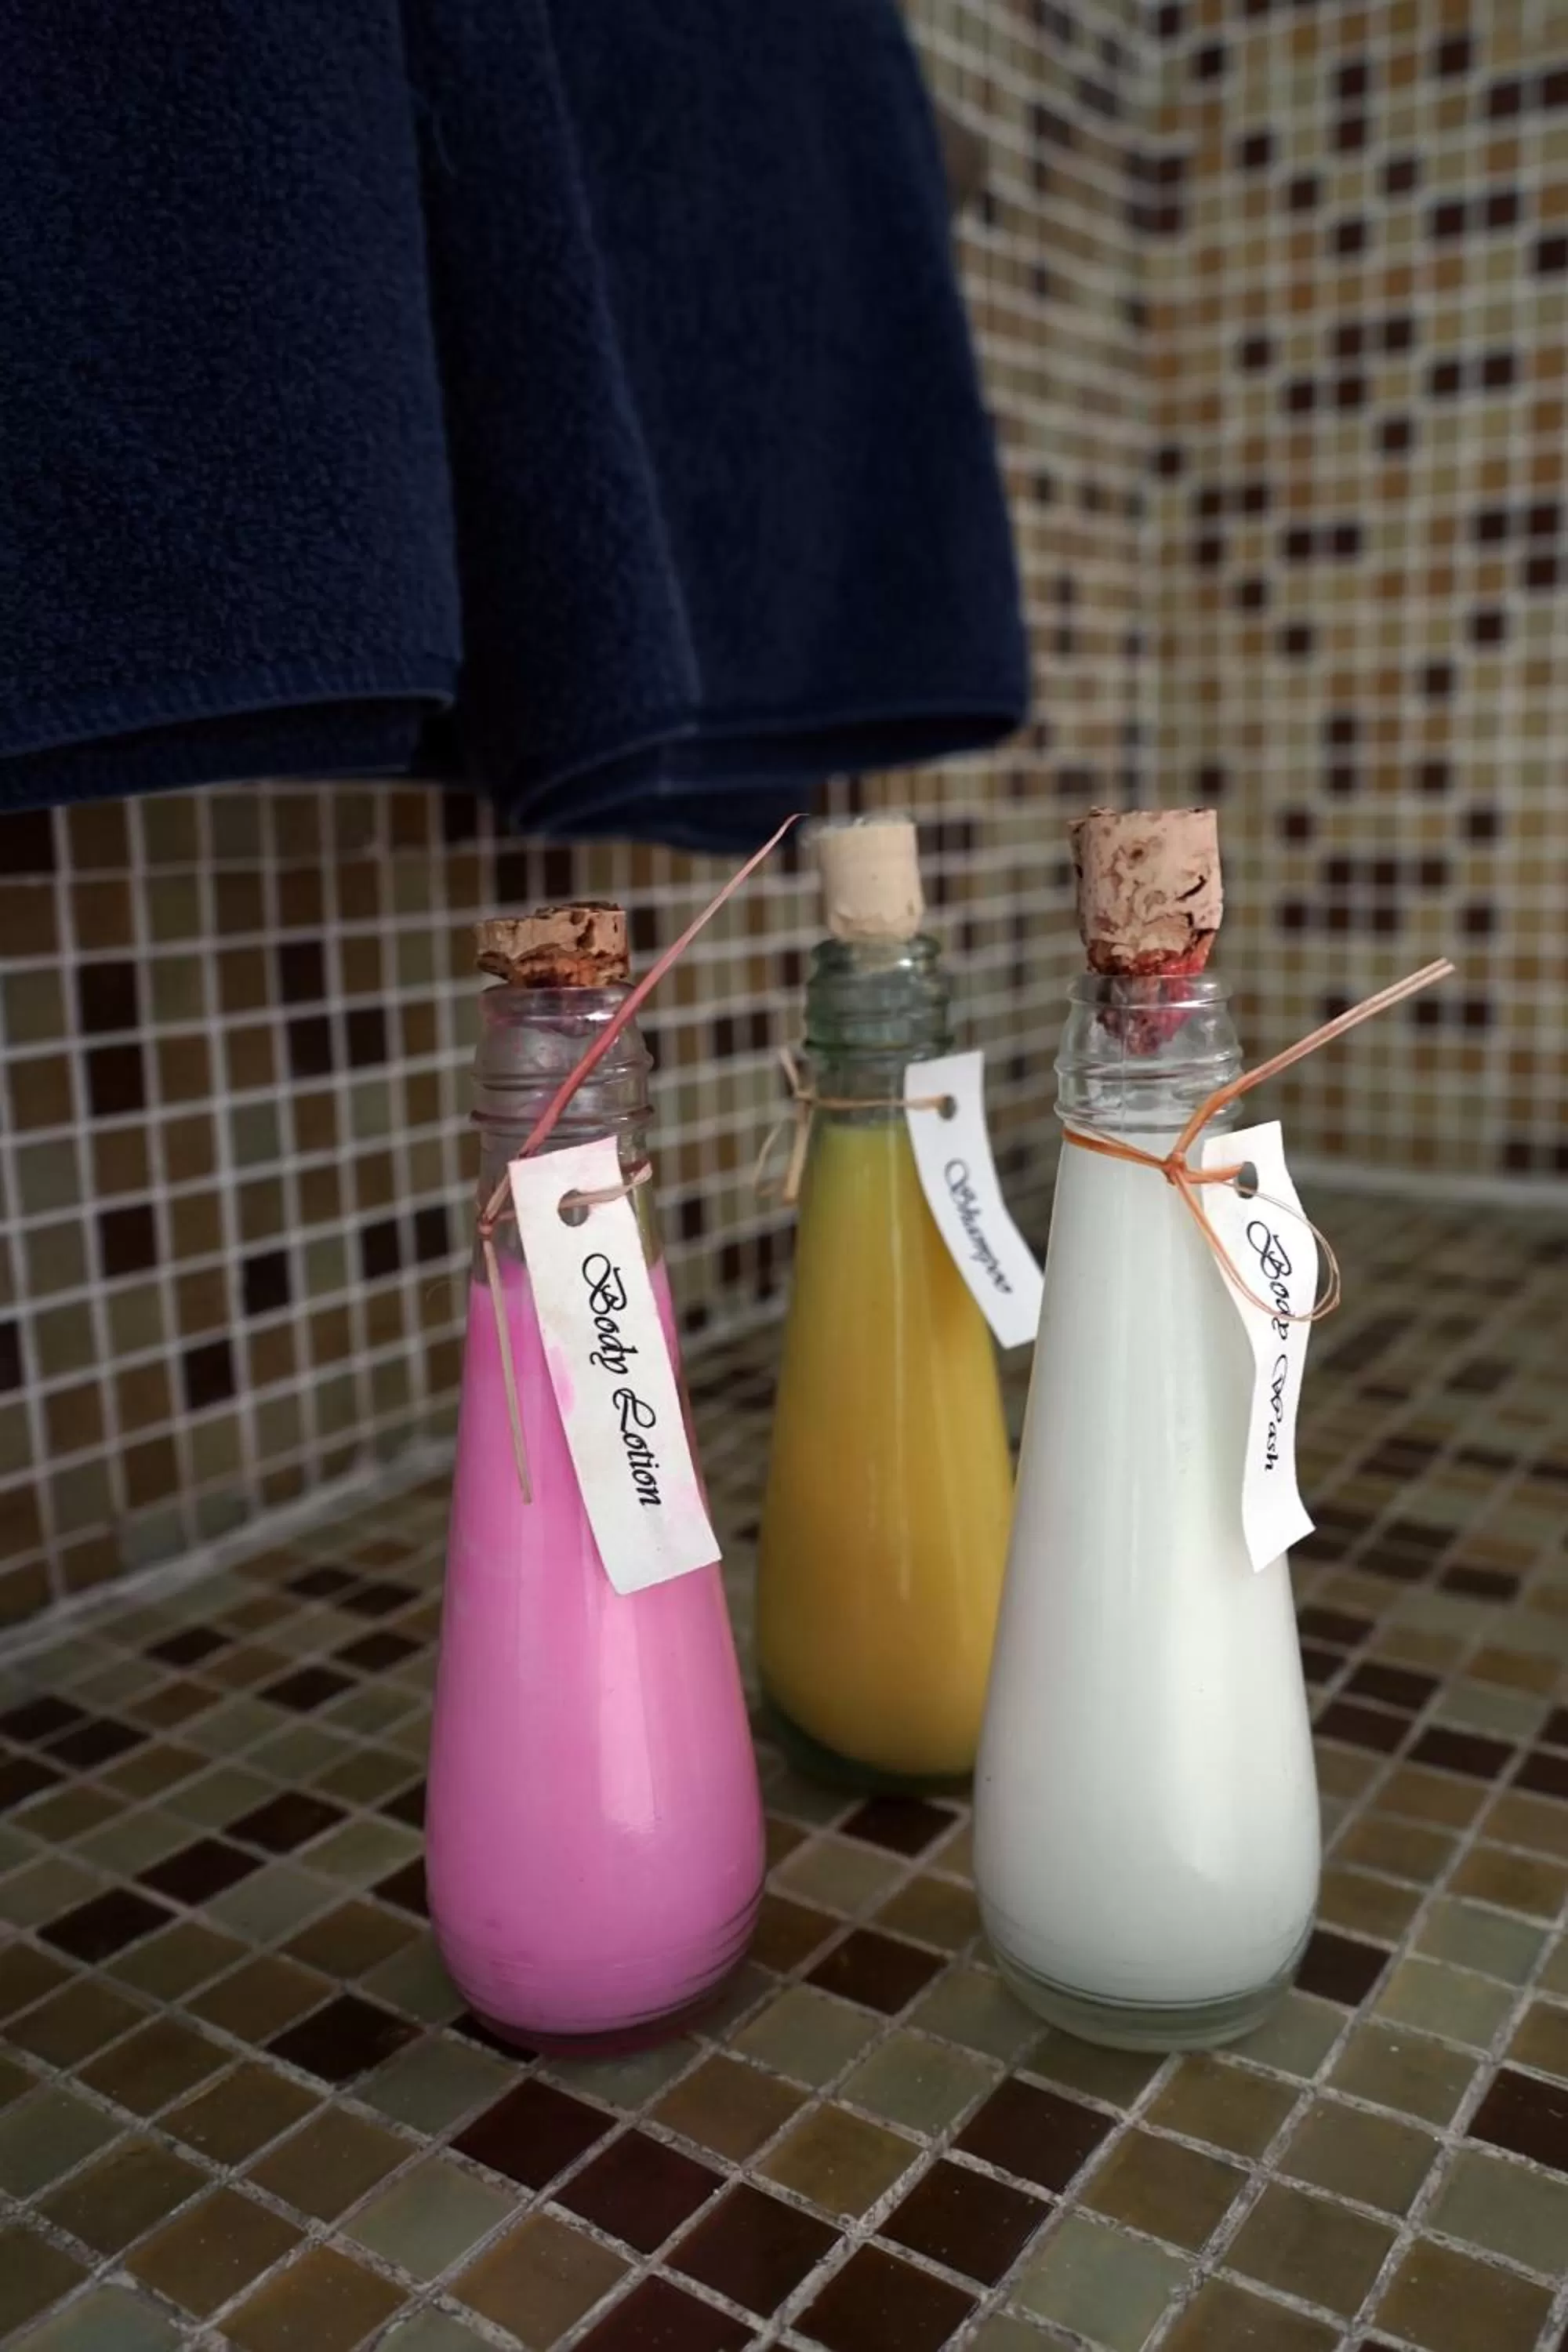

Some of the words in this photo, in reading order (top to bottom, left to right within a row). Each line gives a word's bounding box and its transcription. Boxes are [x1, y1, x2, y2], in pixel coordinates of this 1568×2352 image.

[581, 1252, 638, 1374] Body
[612, 1387, 662, 1507] Lotion
[1265, 1353, 1288, 1472] Wash
